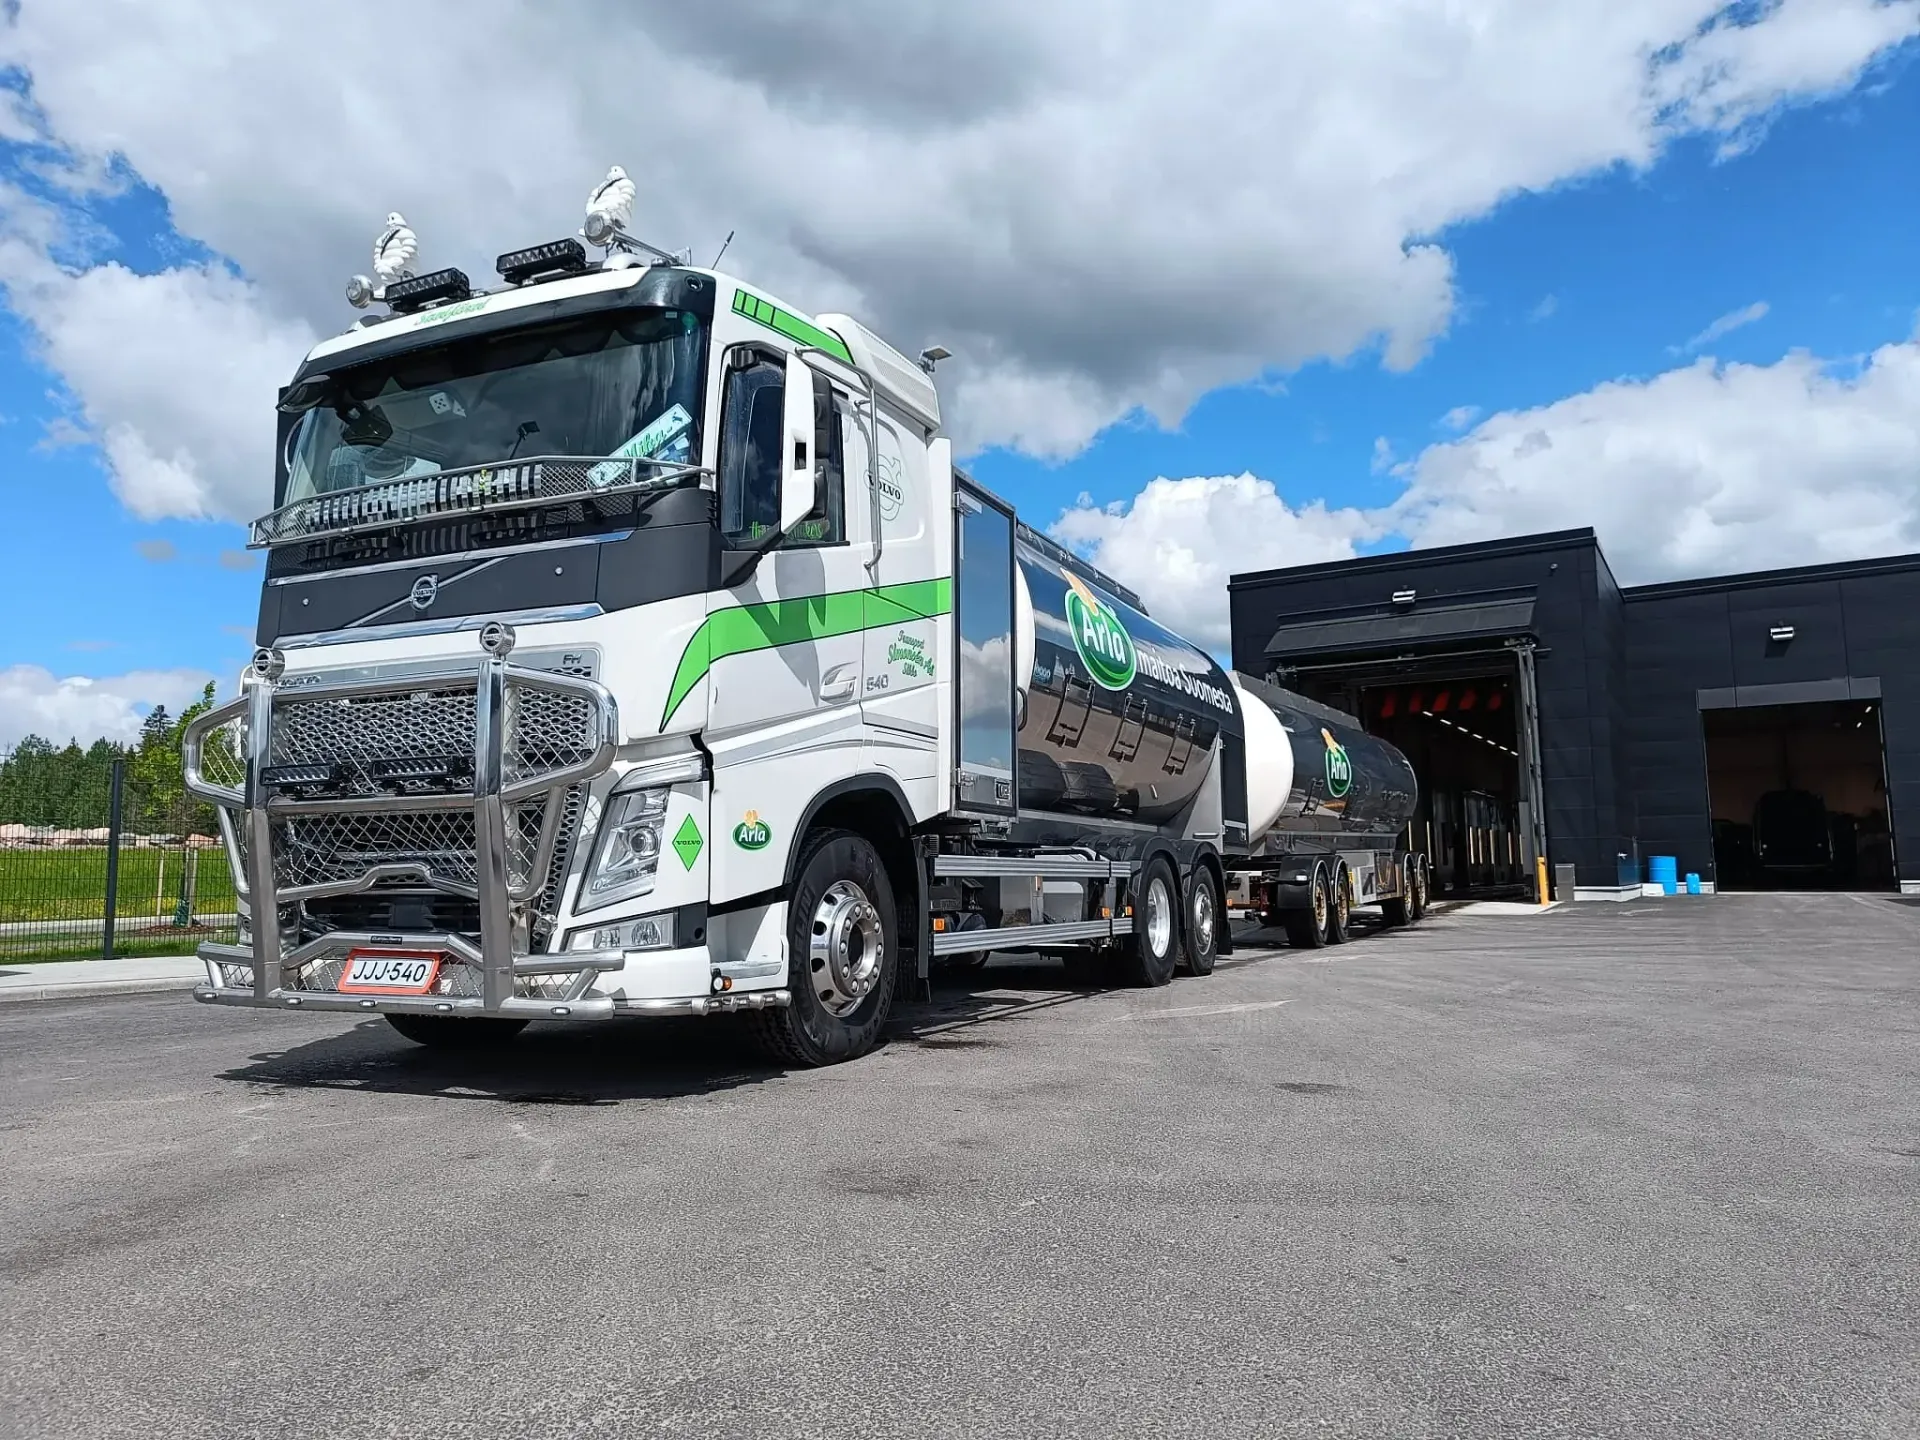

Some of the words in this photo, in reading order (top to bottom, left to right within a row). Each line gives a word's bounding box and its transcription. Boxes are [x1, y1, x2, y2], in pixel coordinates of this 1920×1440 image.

[1081, 604, 1127, 664] Arla
[1137, 648, 1182, 690] maitoa
[1179, 663, 1234, 715] Suomesta
[867, 674, 889, 692] 540
[1331, 753, 1348, 781] Arla
[738, 825, 767, 842] Arla
[352, 961, 427, 983] JJJ-540
